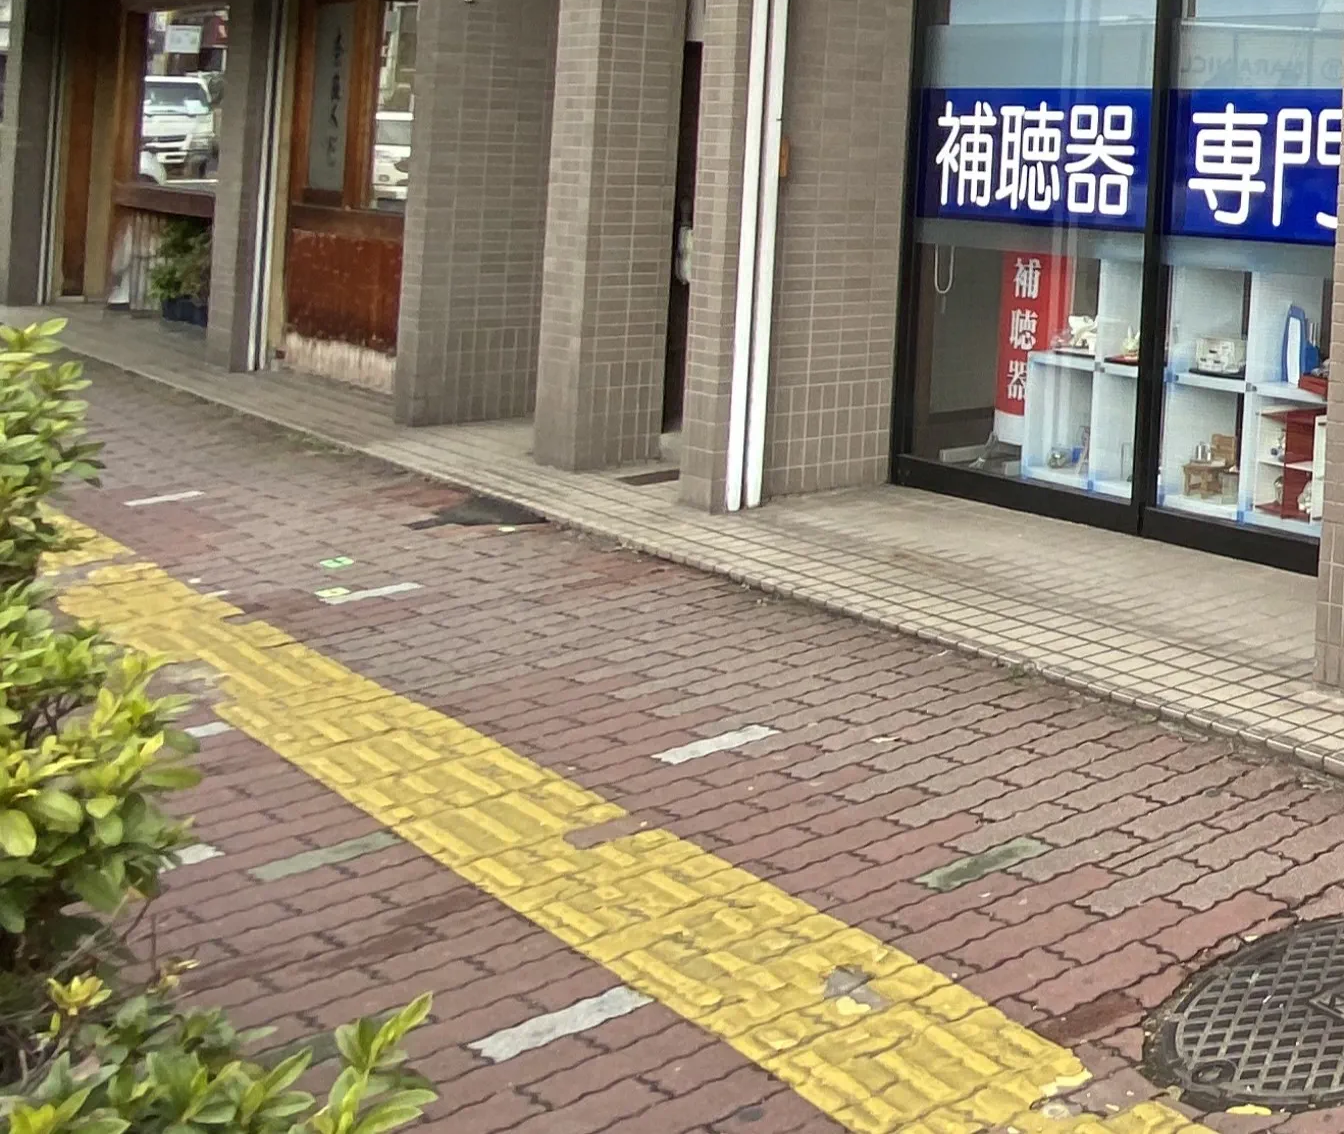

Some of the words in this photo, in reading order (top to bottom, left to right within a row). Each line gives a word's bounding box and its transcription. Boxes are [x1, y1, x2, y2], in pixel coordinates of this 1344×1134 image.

[935, 99, 1136, 217] 補聴器
[1187, 102, 1343, 229] 専門
[1007, 257, 1042, 401] 補聴器
